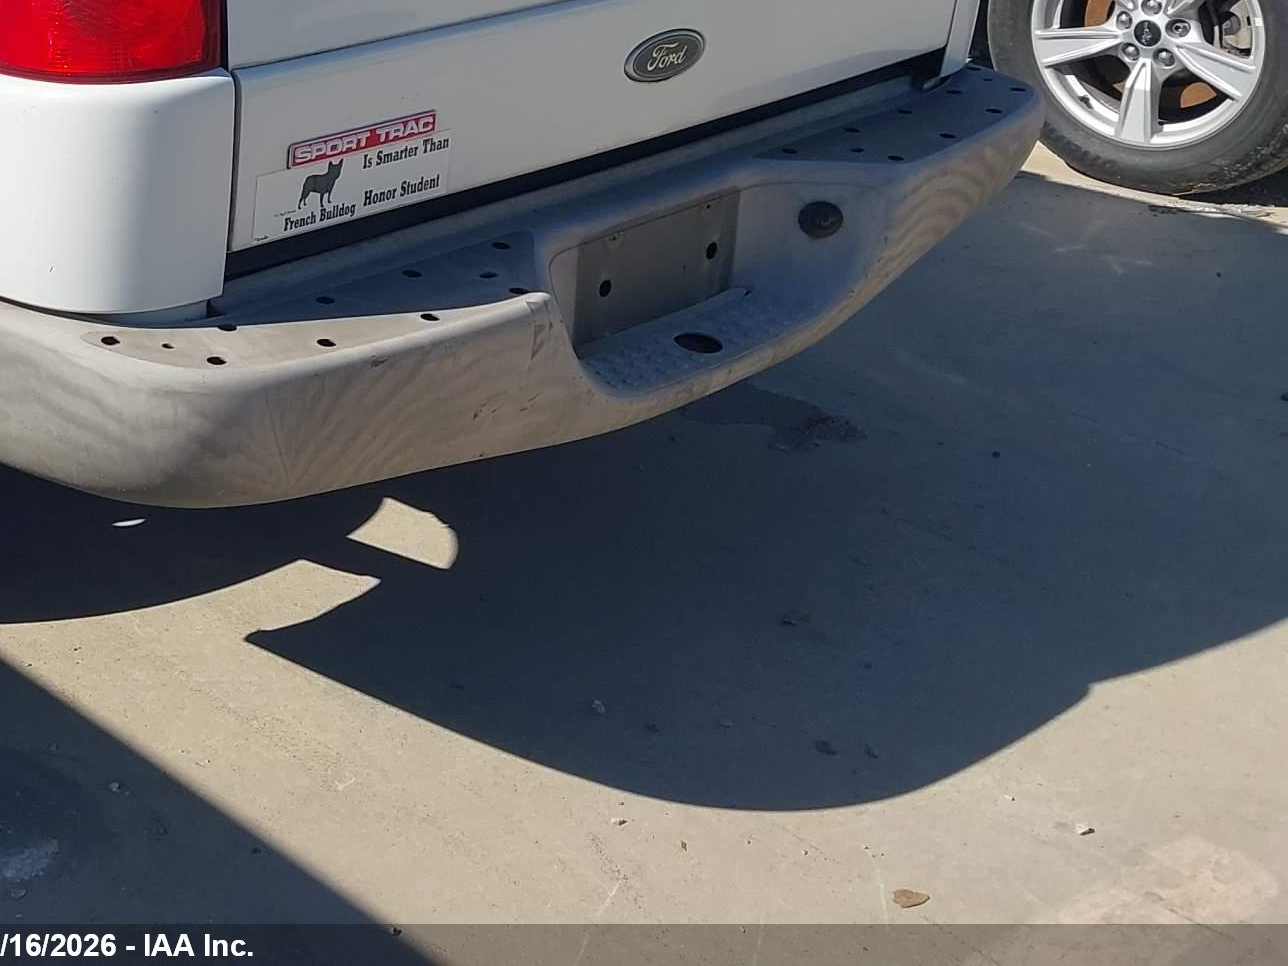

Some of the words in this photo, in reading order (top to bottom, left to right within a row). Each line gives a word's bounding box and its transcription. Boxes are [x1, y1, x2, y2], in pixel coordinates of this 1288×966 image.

[647, 41, 688, 71] Ford
[292, 132, 372, 163] SPORT
[375, 116, 434, 142] TRAC
[363, 153, 373, 169] Is
[376, 144, 419, 166] Smarter
[422, 135, 449, 153] Than
[363, 188, 397, 207] Honor
[400, 174, 440, 197] Student
[283, 211, 317, 232] French
[319, 203, 357, 224] Bulldog
